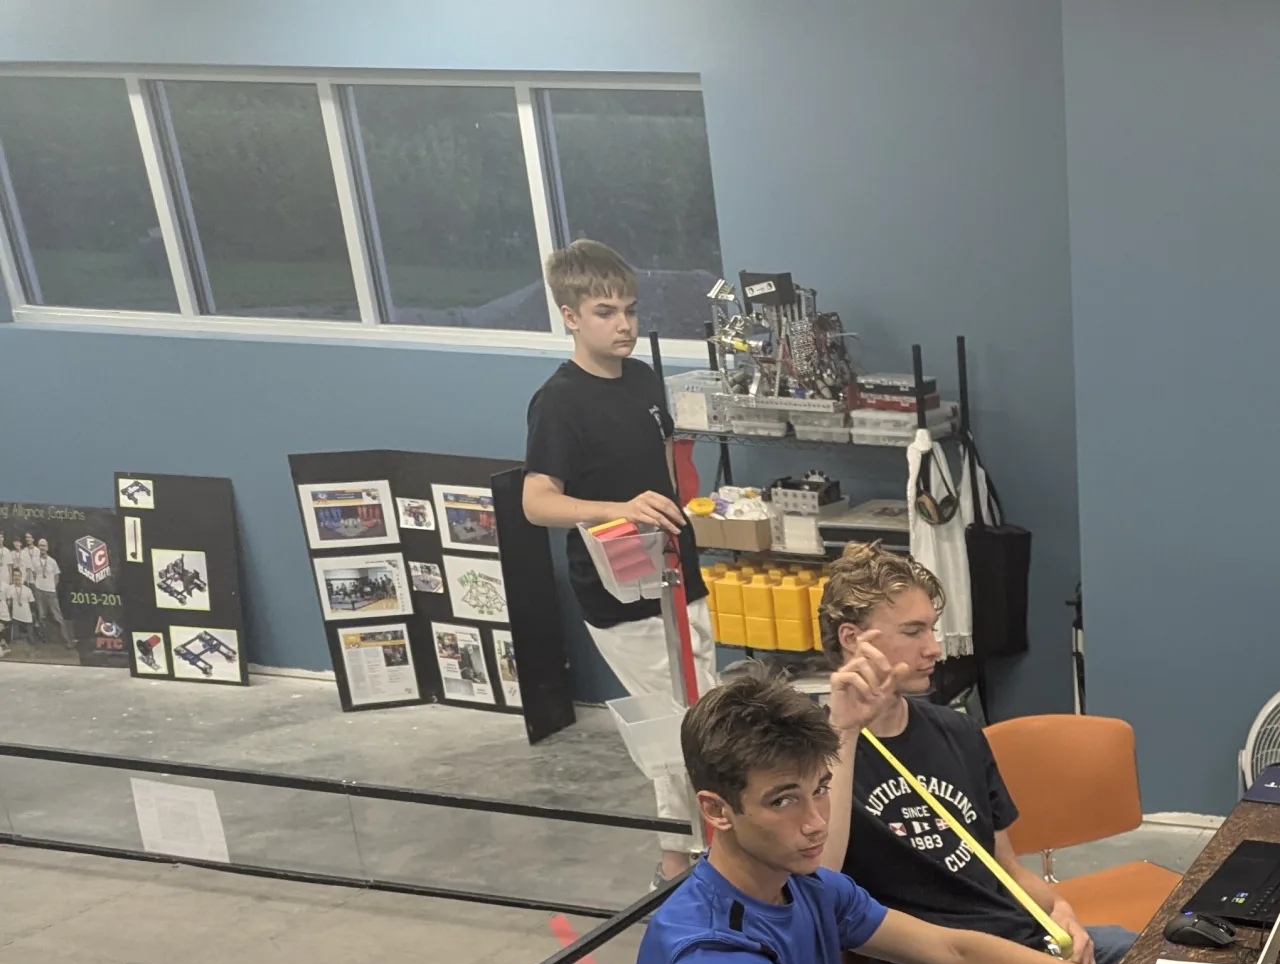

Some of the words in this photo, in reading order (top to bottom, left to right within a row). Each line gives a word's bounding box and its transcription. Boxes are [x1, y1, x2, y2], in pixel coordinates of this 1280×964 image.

[70, 591, 122, 607] 2013-201
[95, 636, 124, 650] FTC
[916, 775, 978, 825] SAILING
[900, 805, 931, 819] SINCE
[910, 834, 944, 851] 1983
